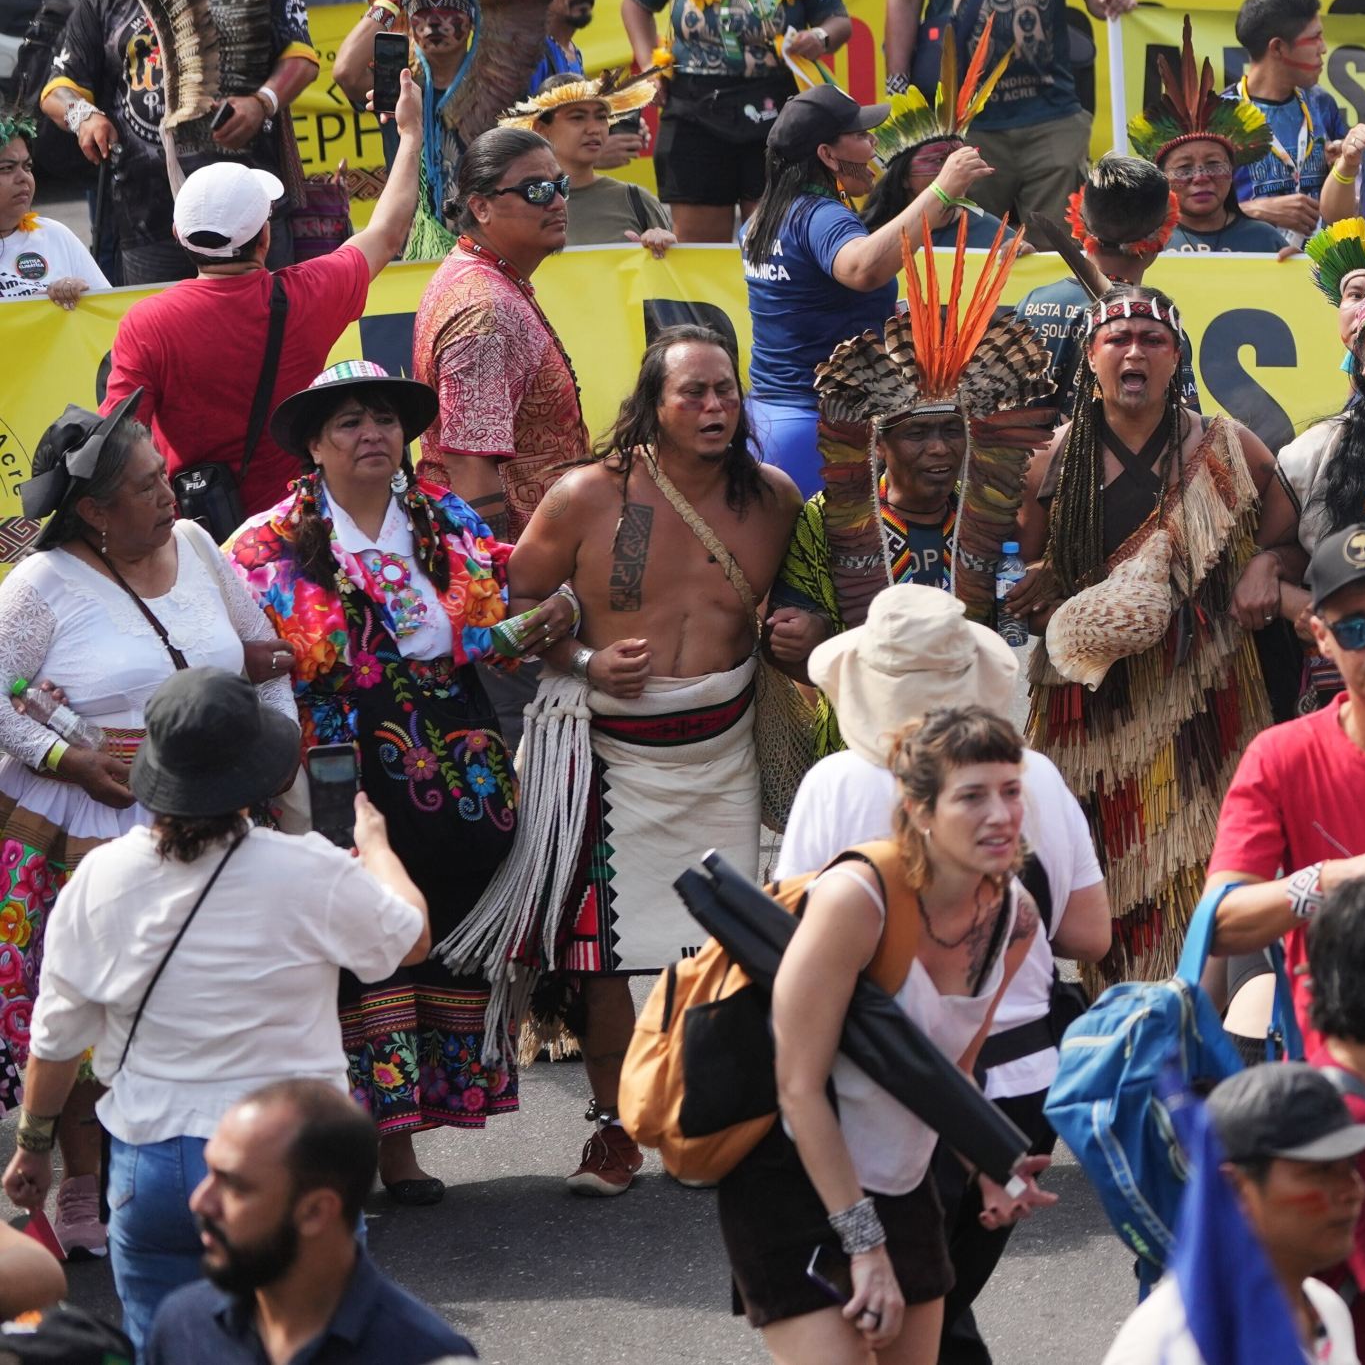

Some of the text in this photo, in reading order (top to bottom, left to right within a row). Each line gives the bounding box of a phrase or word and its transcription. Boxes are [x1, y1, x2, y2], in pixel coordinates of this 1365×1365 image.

[743, 258, 791, 281] MUNICA
[1025, 303, 1081, 319] BASTA DE
[185, 479, 207, 491] FILA
